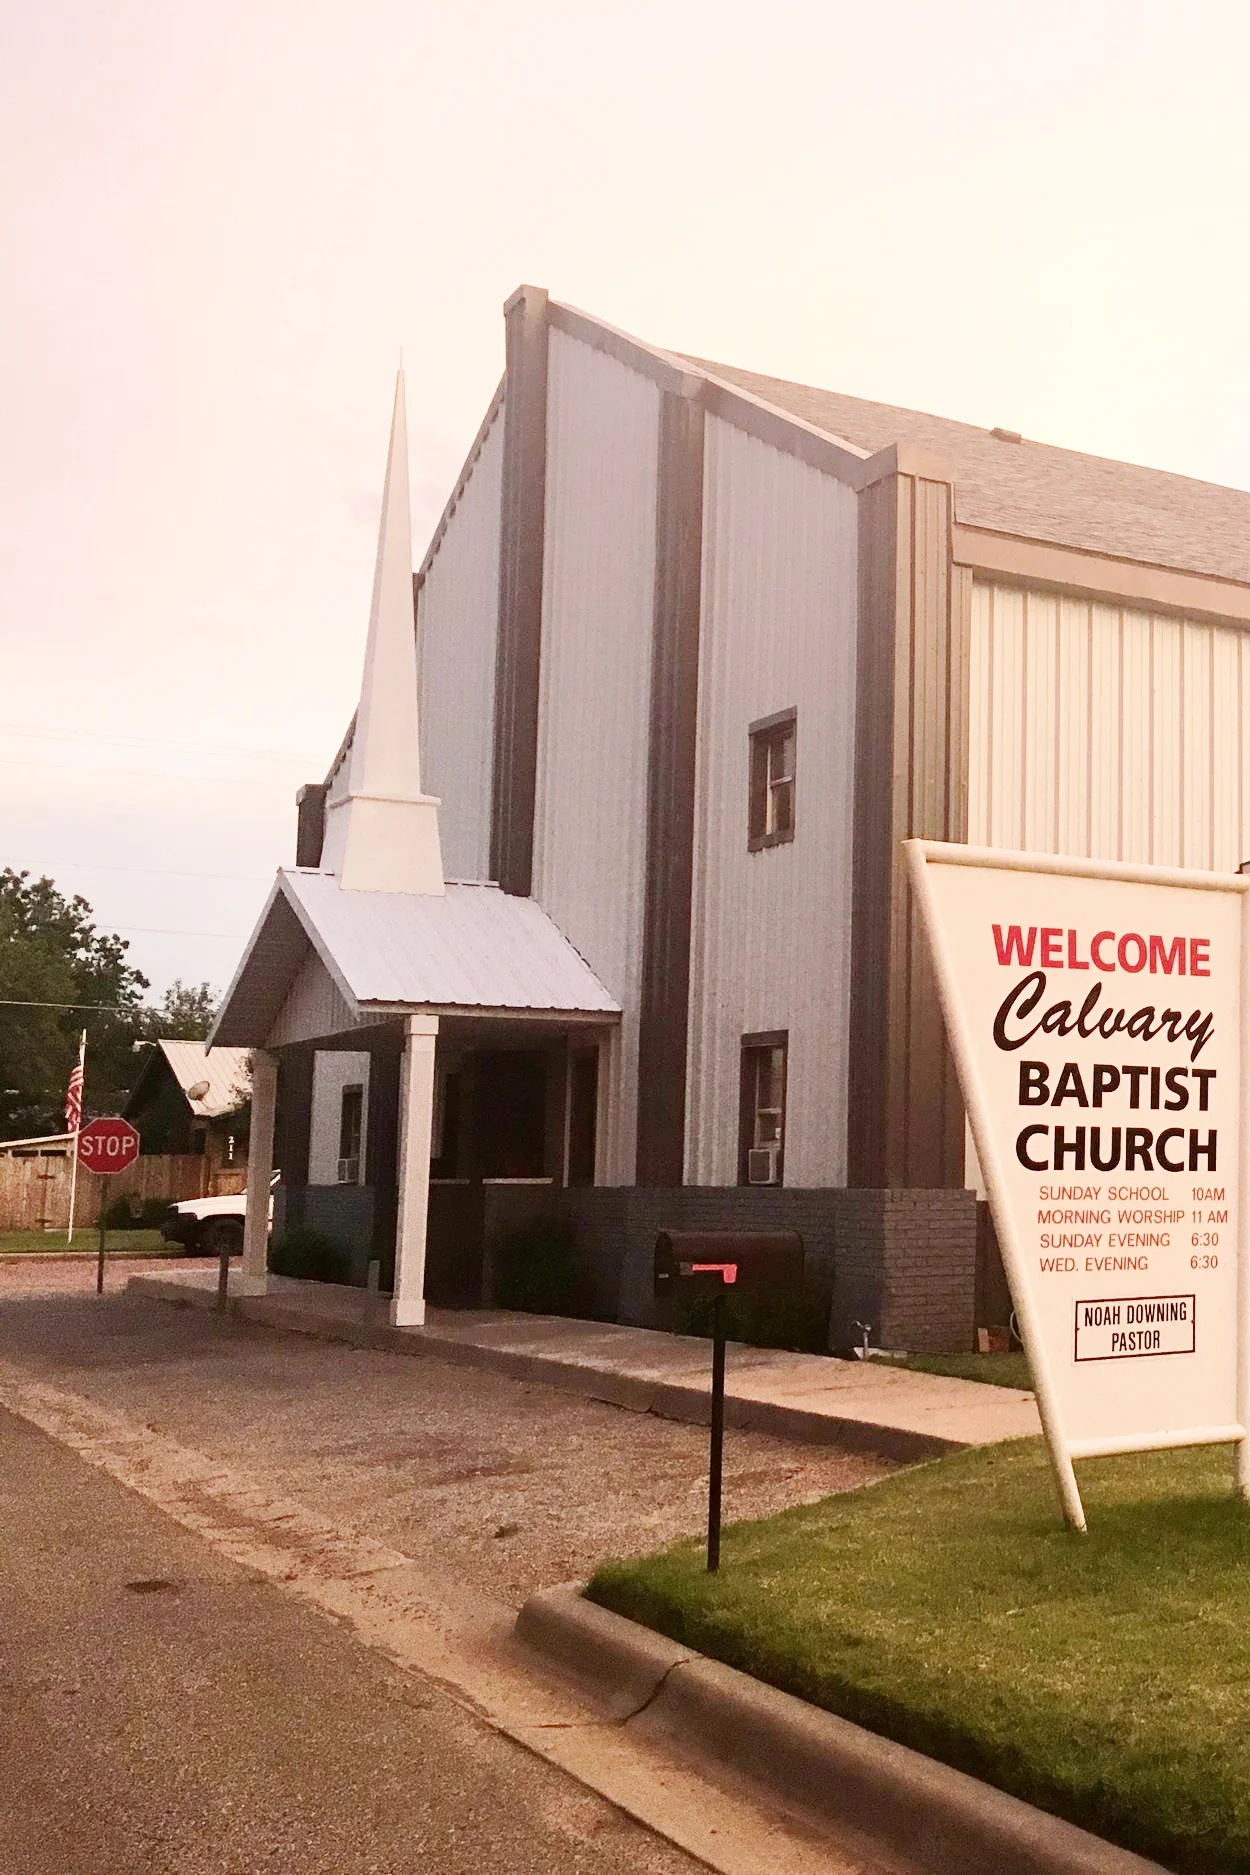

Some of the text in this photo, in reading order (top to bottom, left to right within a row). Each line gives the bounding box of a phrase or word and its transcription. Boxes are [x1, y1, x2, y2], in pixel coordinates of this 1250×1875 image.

[992, 924, 1211, 977] WELCOME
[993, 971, 1215, 1062] Calvary
[1018, 1060, 1217, 1112] BAPTIST
[81, 1136, 135, 1157] STOP
[1015, 1124, 1218, 1172] CHURCH
[1039, 1185, 1225, 1201] SUNDAY SCHOOL 10AM
[1037, 1209, 1228, 1225] MORNING WORSHIP 11 AM
[1040, 1232, 1219, 1249] SUNDAY EVENING 6:30
[1040, 1255, 1218, 1273] WED. EVENING 6:30
[1084, 1301, 1187, 1327] NOAH DOWNING
[1111, 1330, 1161, 1352] PASTOR
